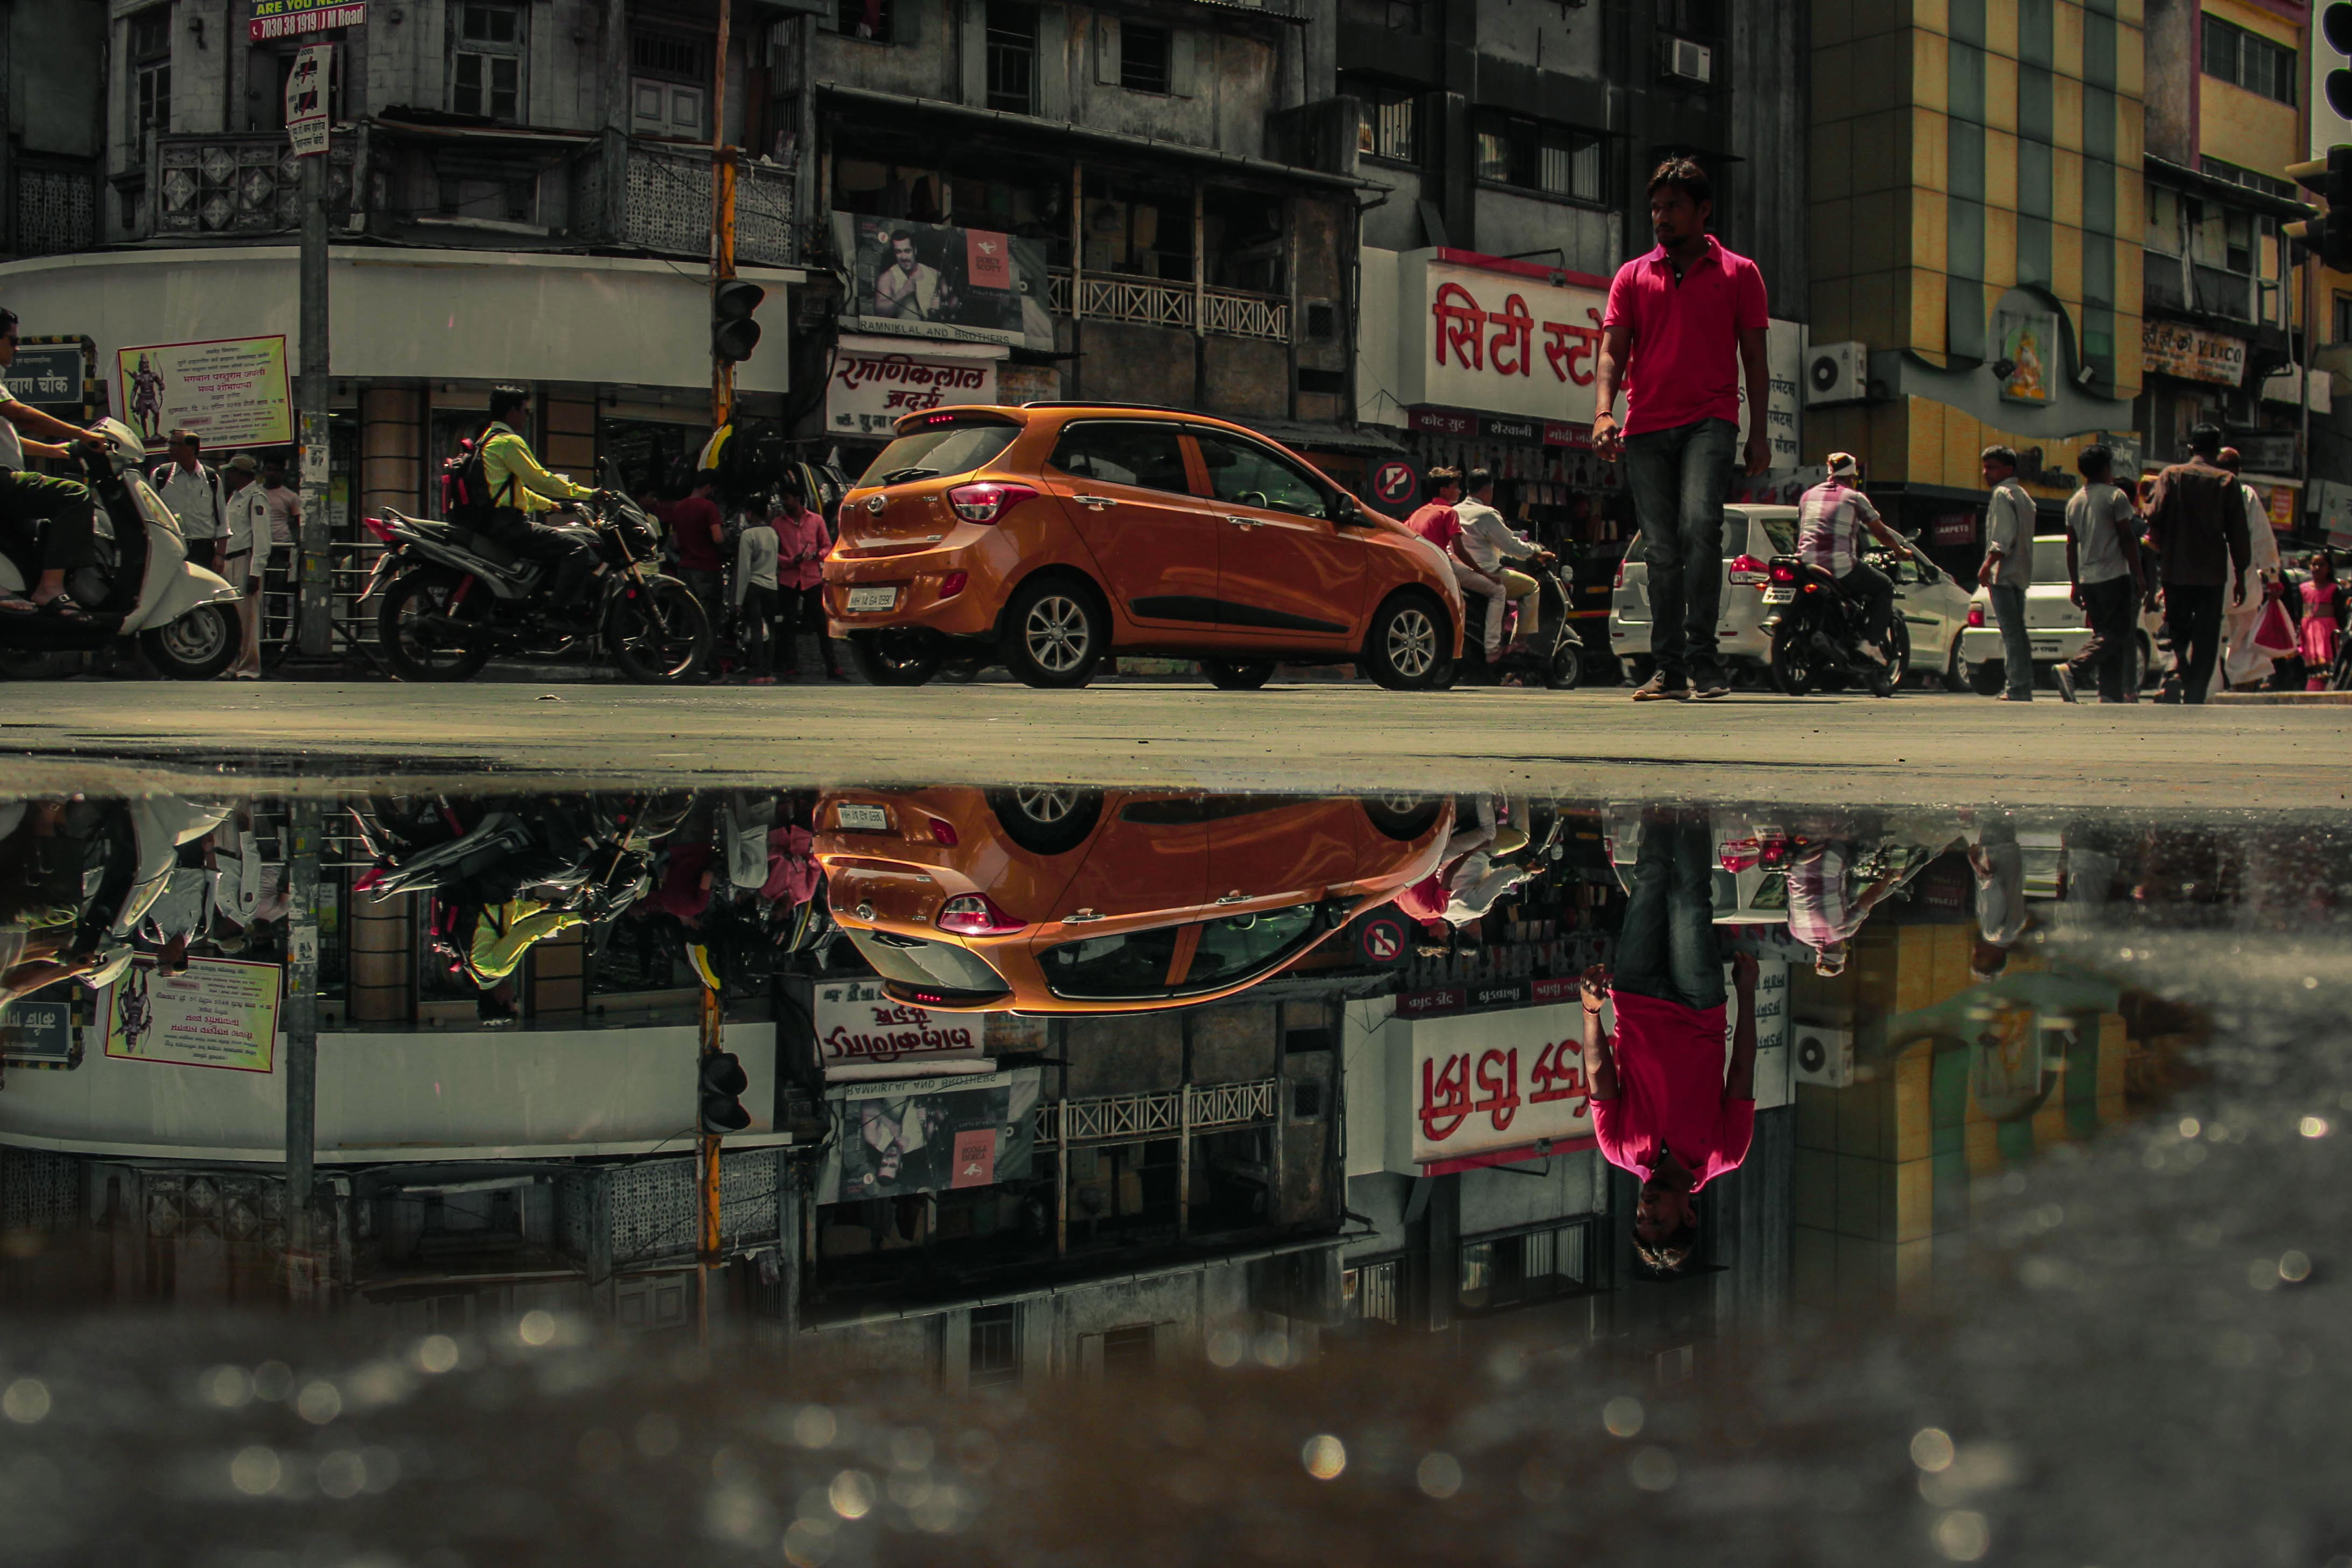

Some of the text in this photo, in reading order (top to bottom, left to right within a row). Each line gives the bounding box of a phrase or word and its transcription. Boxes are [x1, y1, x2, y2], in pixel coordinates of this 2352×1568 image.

[256, 2, 282, 16] ARE
[287, 0, 312, 10] YOU
[262, 6, 363, 38] 7030 38 1919 J M Road
[299, 47, 314, 57] OODS
[862, 321, 1010, 344] RAMNIKLAL AND BROTHERS
[1432, 282, 1605, 386] सिटी स्टो
[184, 374, 210, 383] भगवान
[213, 373, 241, 382] परशुराम
[837, 353, 987, 389] रमणिकलाल
[37, 369, 68, 394] चौक
[217, 381, 251, 391] शोभायात्रा
[884, 387, 944, 411] ब्रदर्स
[1421, 414, 1465, 431] कोट सुट
[1490, 421, 1532, 437] शेरवानी
[1549, 430, 1572, 442] मोदी
